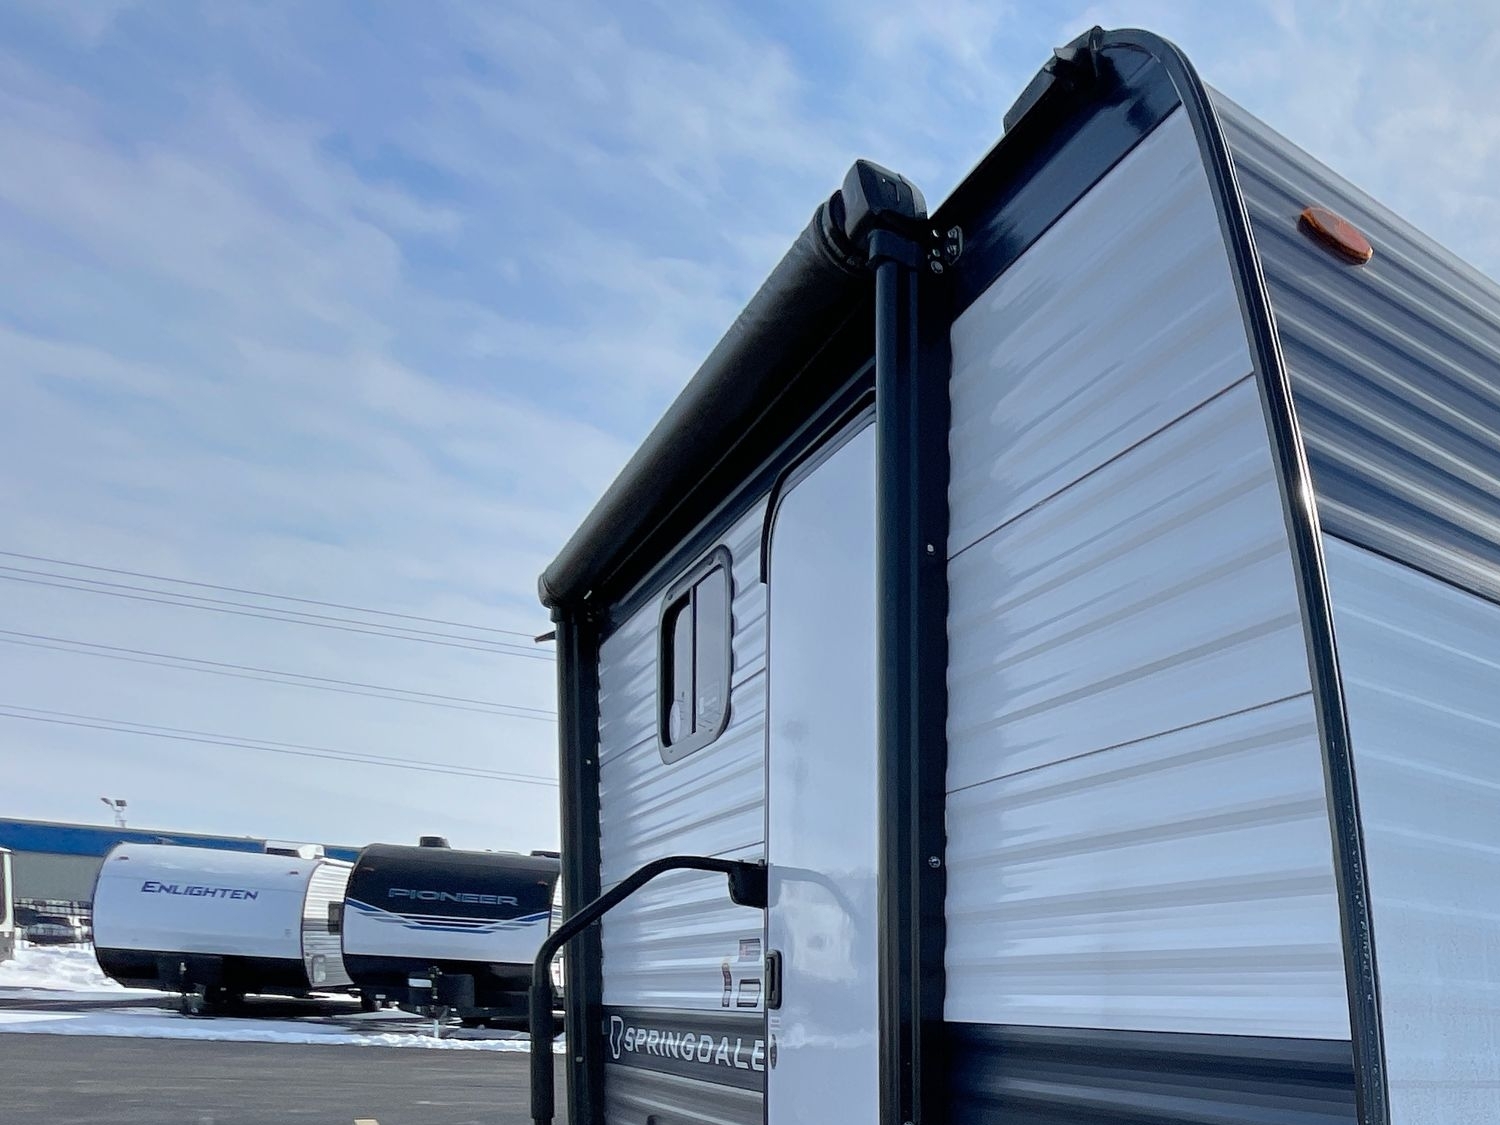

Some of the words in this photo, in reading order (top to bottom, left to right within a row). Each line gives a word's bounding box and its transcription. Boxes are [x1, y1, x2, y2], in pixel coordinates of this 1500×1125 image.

[141, 880, 259, 901] ENLIGHTEN
[388, 887, 519, 906] PIONEER
[624, 1027, 765, 1072] SPRINGDALE
